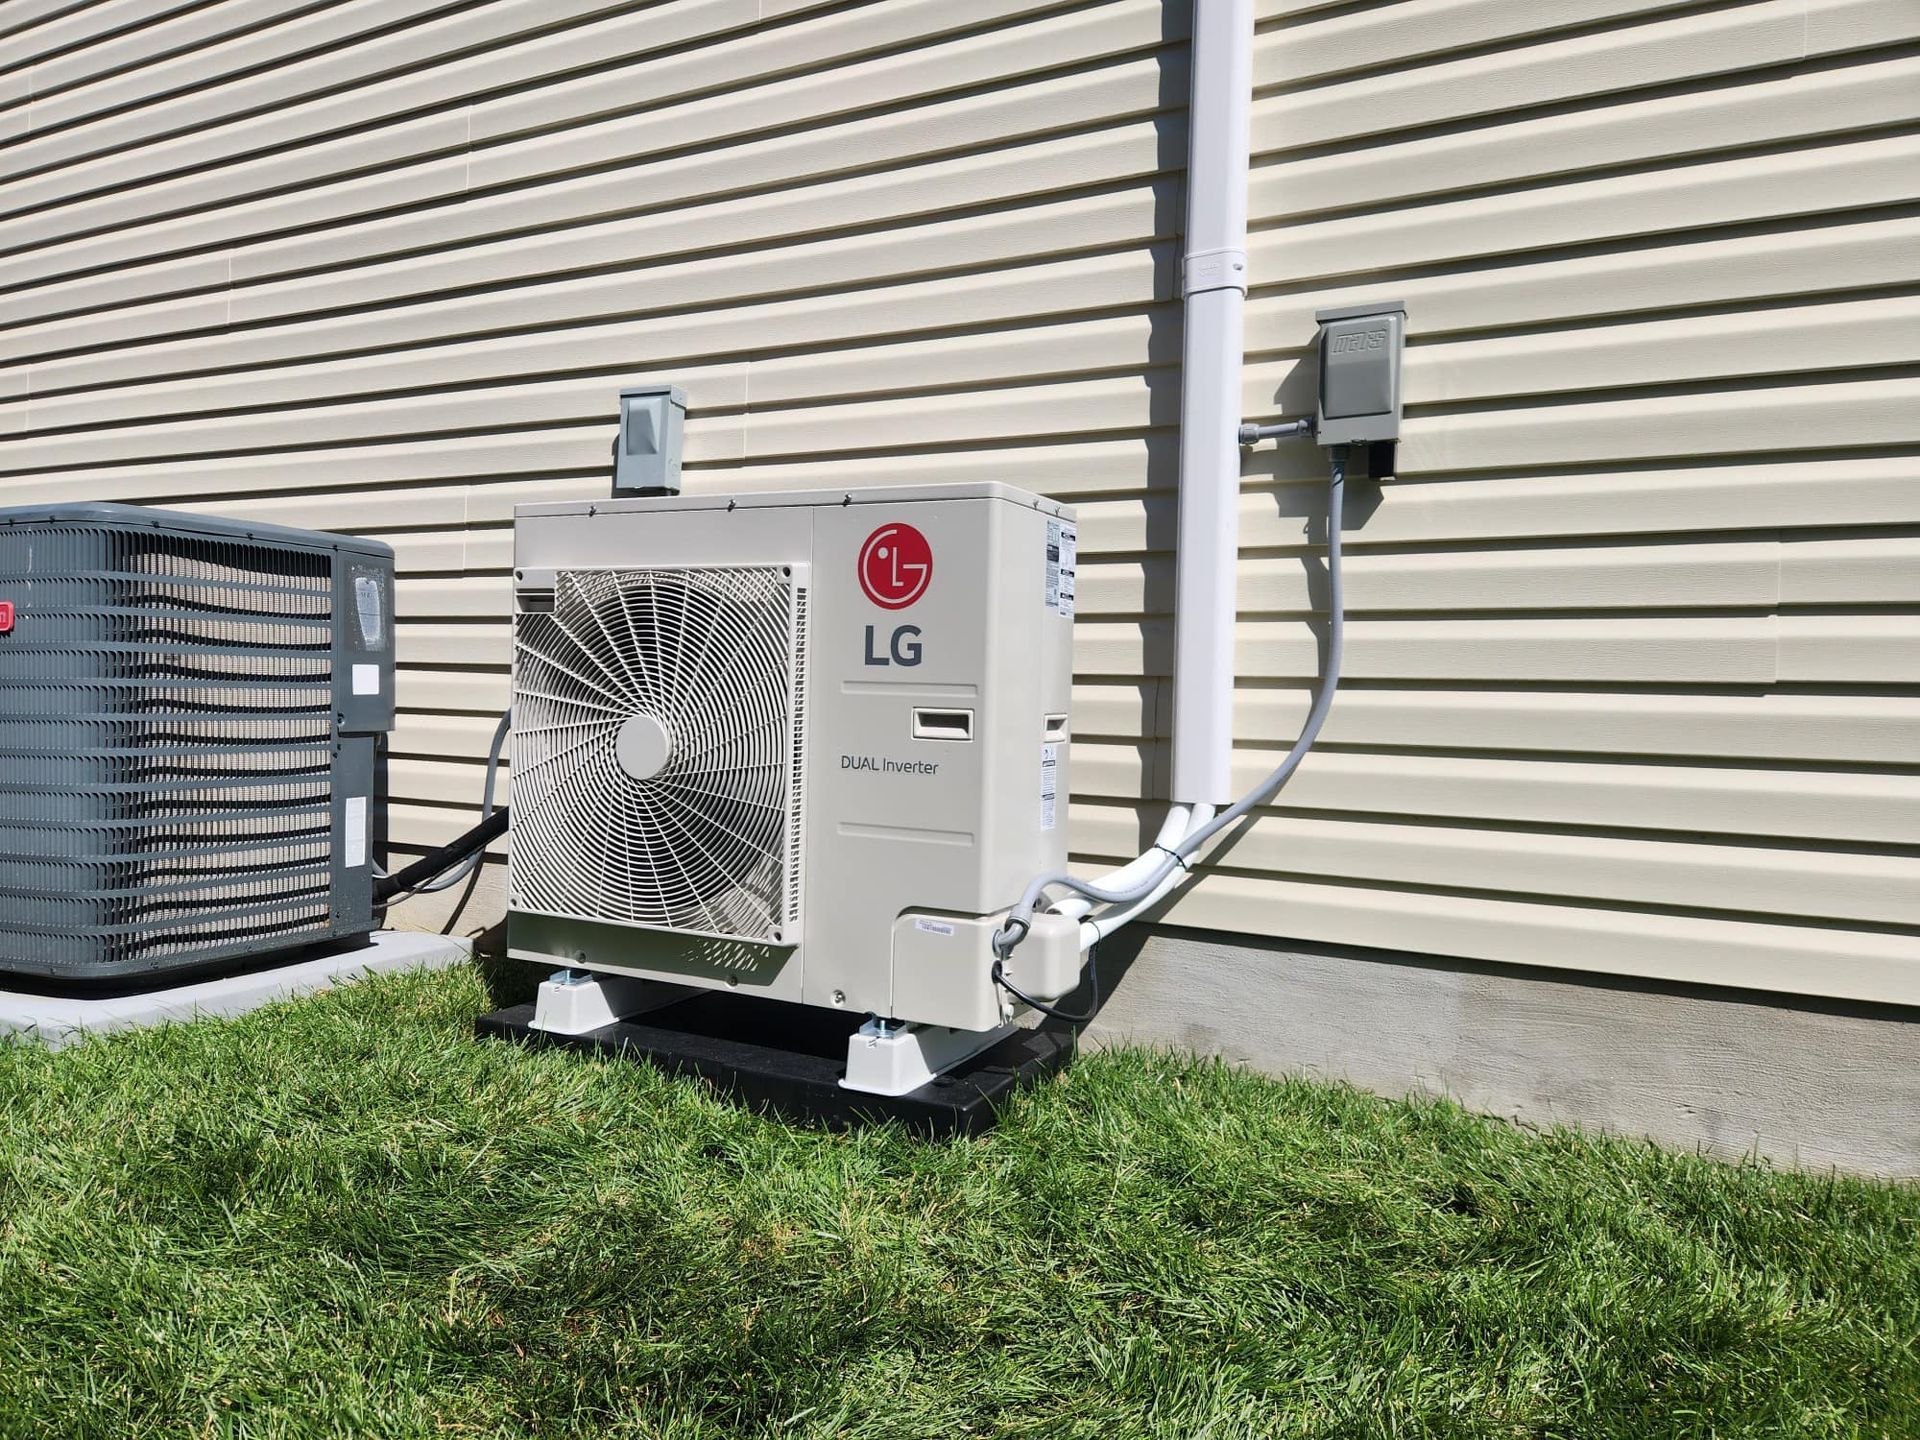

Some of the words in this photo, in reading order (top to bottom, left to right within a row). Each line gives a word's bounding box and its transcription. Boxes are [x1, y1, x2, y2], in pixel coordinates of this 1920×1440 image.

[861, 527, 930, 606] LG
[865, 625, 922, 666] LG
[841, 755, 880, 771] DUAL
[882, 757, 939, 775] Inverter
